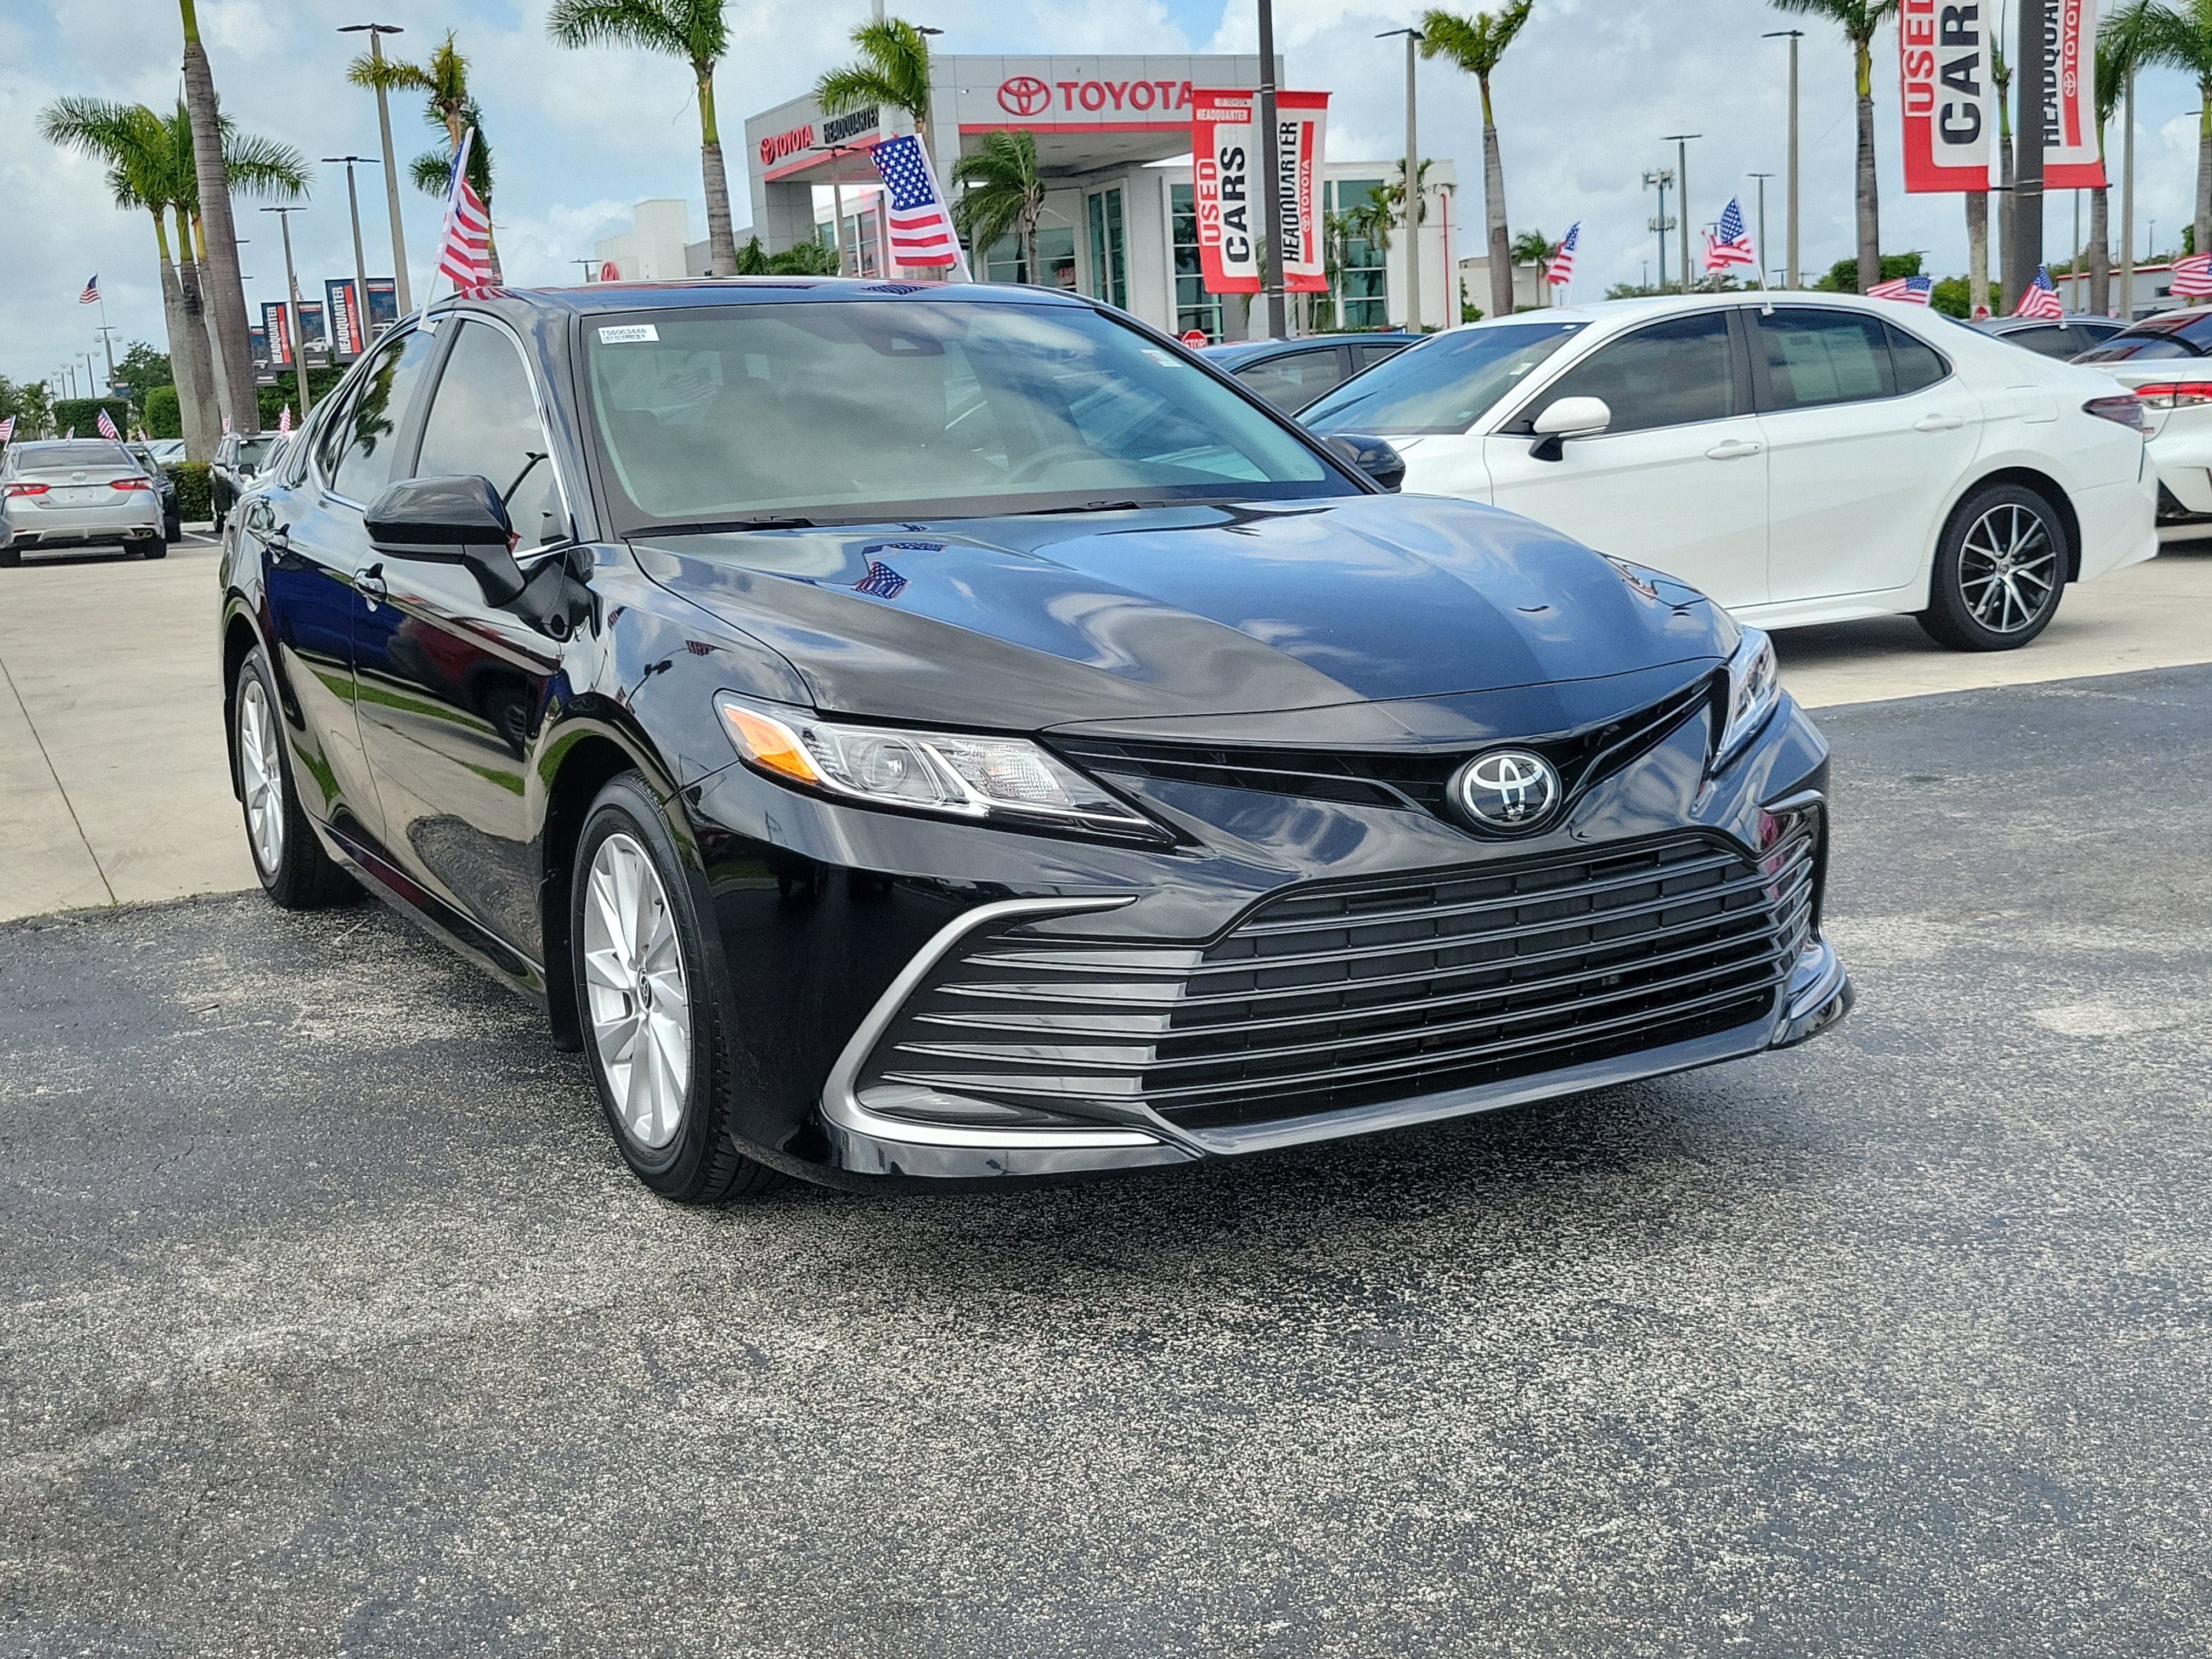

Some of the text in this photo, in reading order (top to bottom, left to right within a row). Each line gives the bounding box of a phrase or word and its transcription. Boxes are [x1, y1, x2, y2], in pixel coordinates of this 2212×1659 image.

[2065, 0, 2078, 69] TOYOT
[1056, 81, 1193, 111] TOYOTA
[1939, 0, 1981, 145] CAR
[2042, 0, 2061, 147] HEADQUA
[775, 125, 814, 157] TOYOTA
[1196, 109, 1248, 121] HEADQUARTER
[1198, 160, 1222, 245] USED
[1220, 146, 1250, 263] CARS
[1279, 122, 1300, 263] HEADQUARTER
[1301, 159, 1311, 215] TOYOTA
[267, 306, 283, 364] HEADQUARTER
[332, 286, 352, 354] HEADQUARTER
[1184, 338, 1206, 351] STOP
